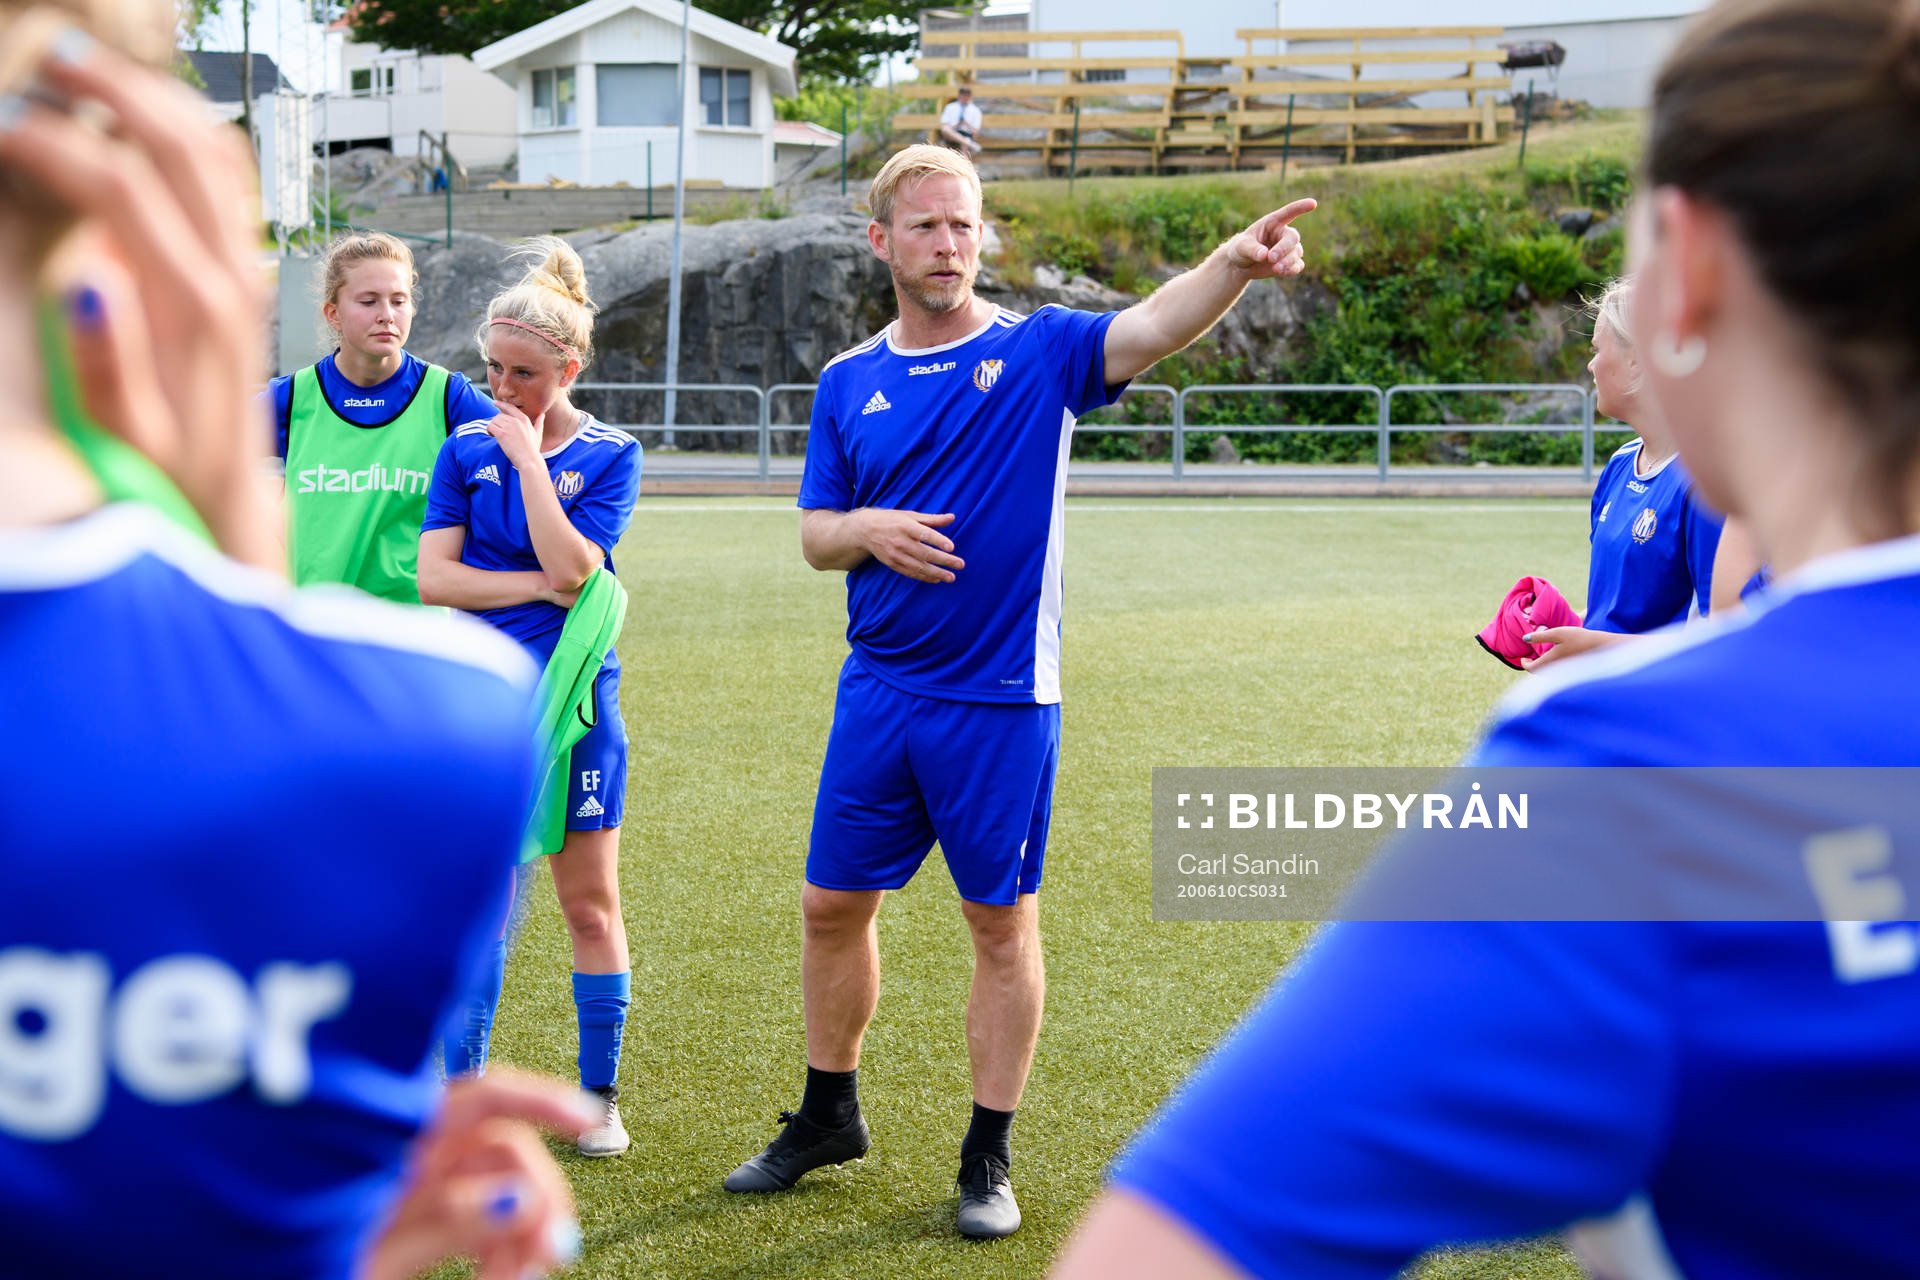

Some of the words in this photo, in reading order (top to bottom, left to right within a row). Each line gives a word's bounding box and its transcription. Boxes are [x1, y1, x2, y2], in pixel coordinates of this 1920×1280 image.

[908, 361, 957, 376] stadium
[343, 398, 385, 407] stadium
[861, 402, 892, 415] adidas
[297, 462, 430, 496] stadium
[581, 770, 601, 792] EF
